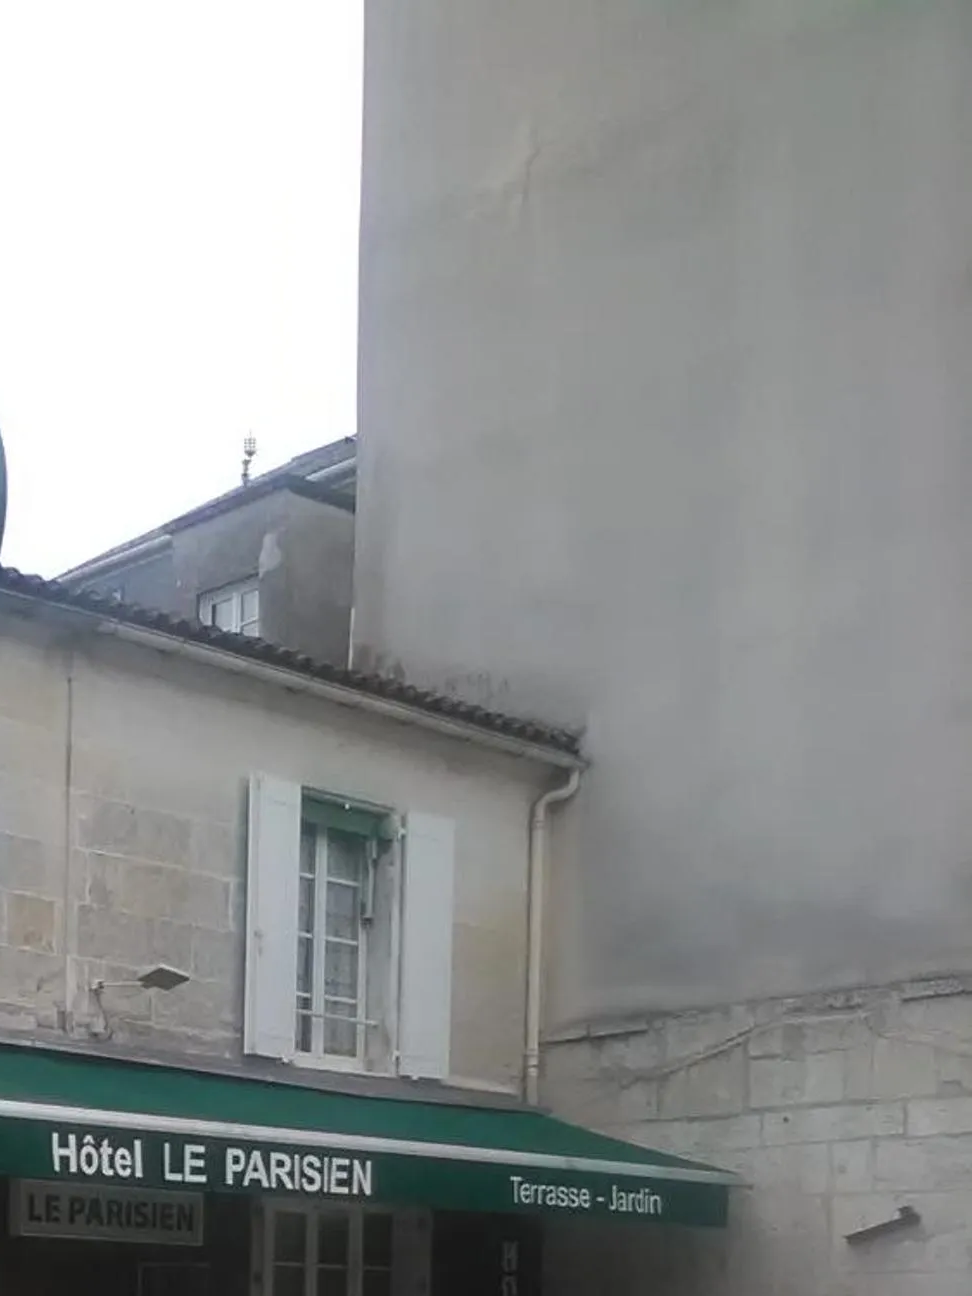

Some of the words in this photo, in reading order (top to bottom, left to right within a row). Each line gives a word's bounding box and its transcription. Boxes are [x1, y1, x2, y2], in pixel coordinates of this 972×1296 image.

[52, 1132, 144, 1178] Hôtel
[163, 1142, 207, 1184] LE
[225, 1147, 372, 1196] PARISIEN
[28, 1193, 61, 1225] LE
[68, 1197, 195, 1232] PARISIEN
[510, 1175, 591, 1208] Terrasse
[609, 1185, 662, 1214] Jardin
